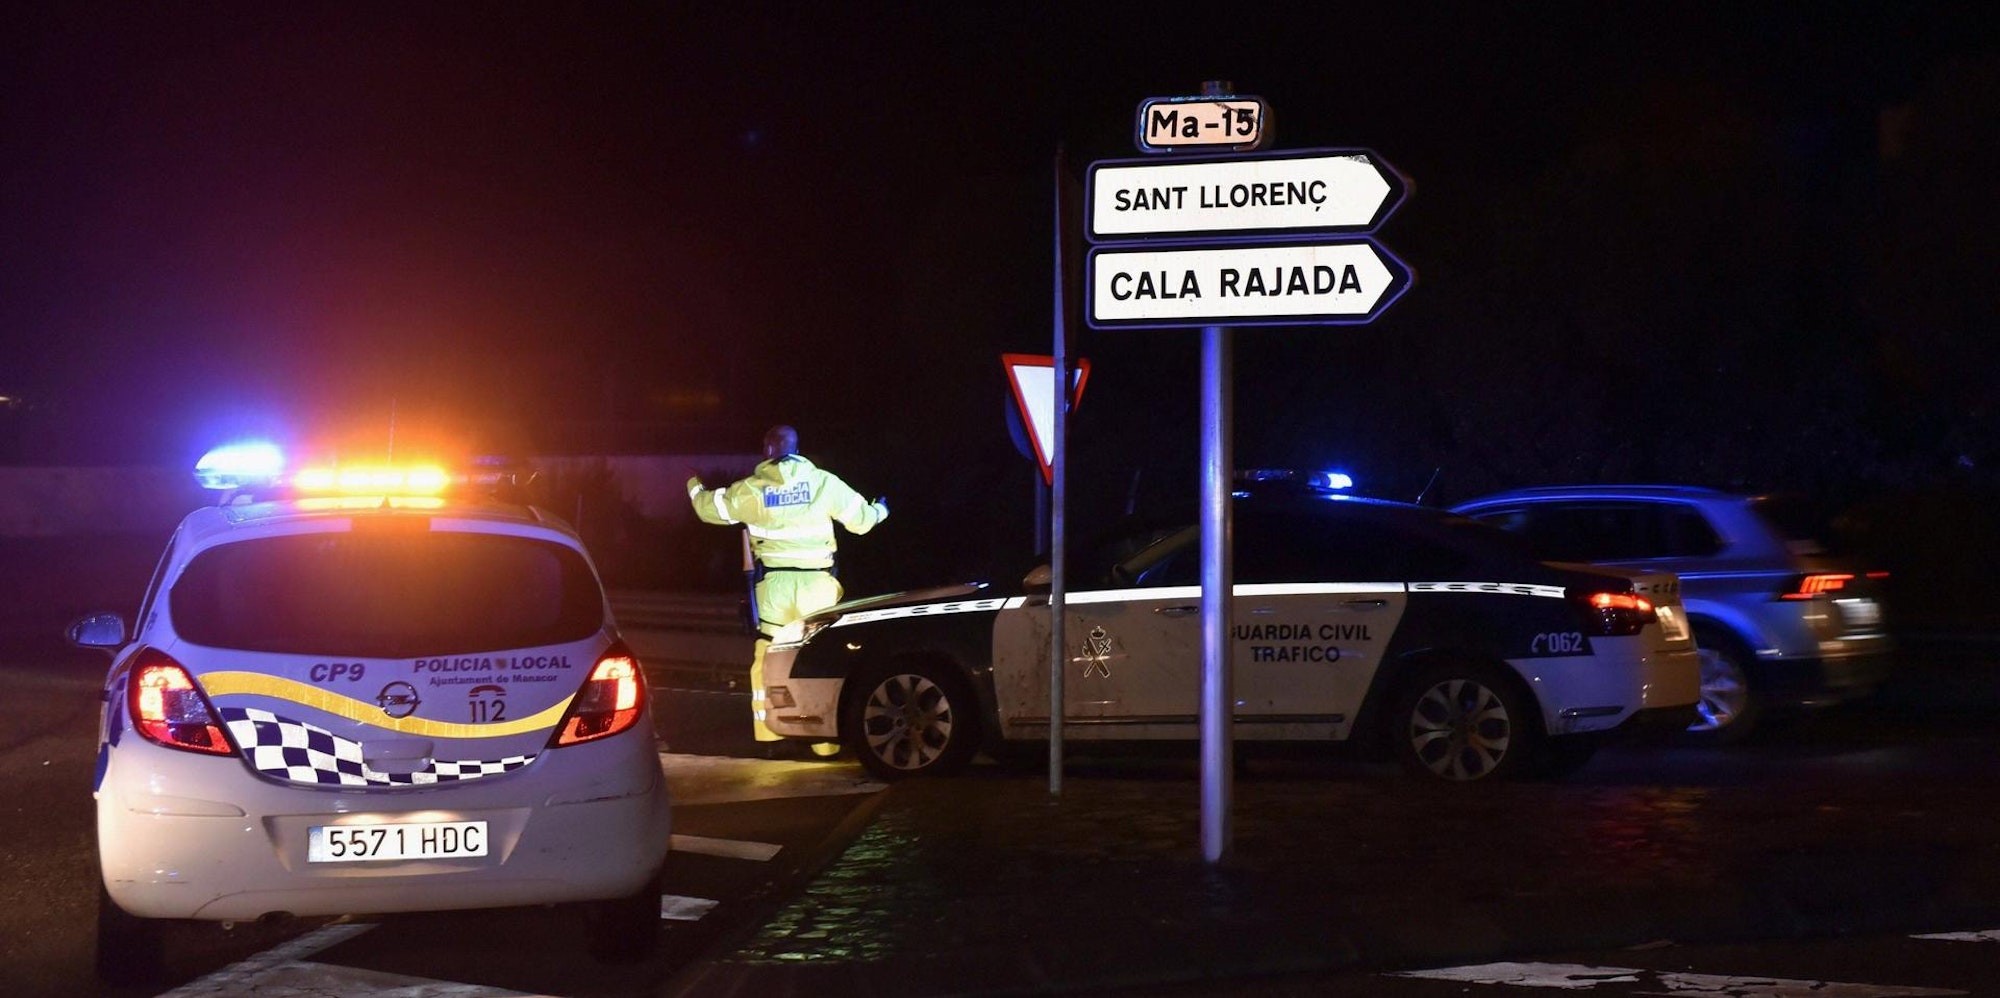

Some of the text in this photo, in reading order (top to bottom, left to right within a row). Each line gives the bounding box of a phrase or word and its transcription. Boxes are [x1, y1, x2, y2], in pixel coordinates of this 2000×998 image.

[1150, 108, 1254, 138] Ma-15
[1114, 181, 1327, 212] SANT LLORENÇ
[1110, 264, 1362, 301] CALA RAJADA
[779, 491, 810, 504] LOCAL
[1319, 624, 1371, 640] CIVIL
[1549, 631, 1584, 653] 062
[414, 656, 571, 673] POLICIA LOCAL
[1251, 646, 1340, 662] TRAFICO
[310, 663, 366, 683] CP9
[430, 674, 558, 687] Ajuntament de Manacor
[469, 700, 506, 723] 112
[330, 826, 480, 857] 5571 HDC
